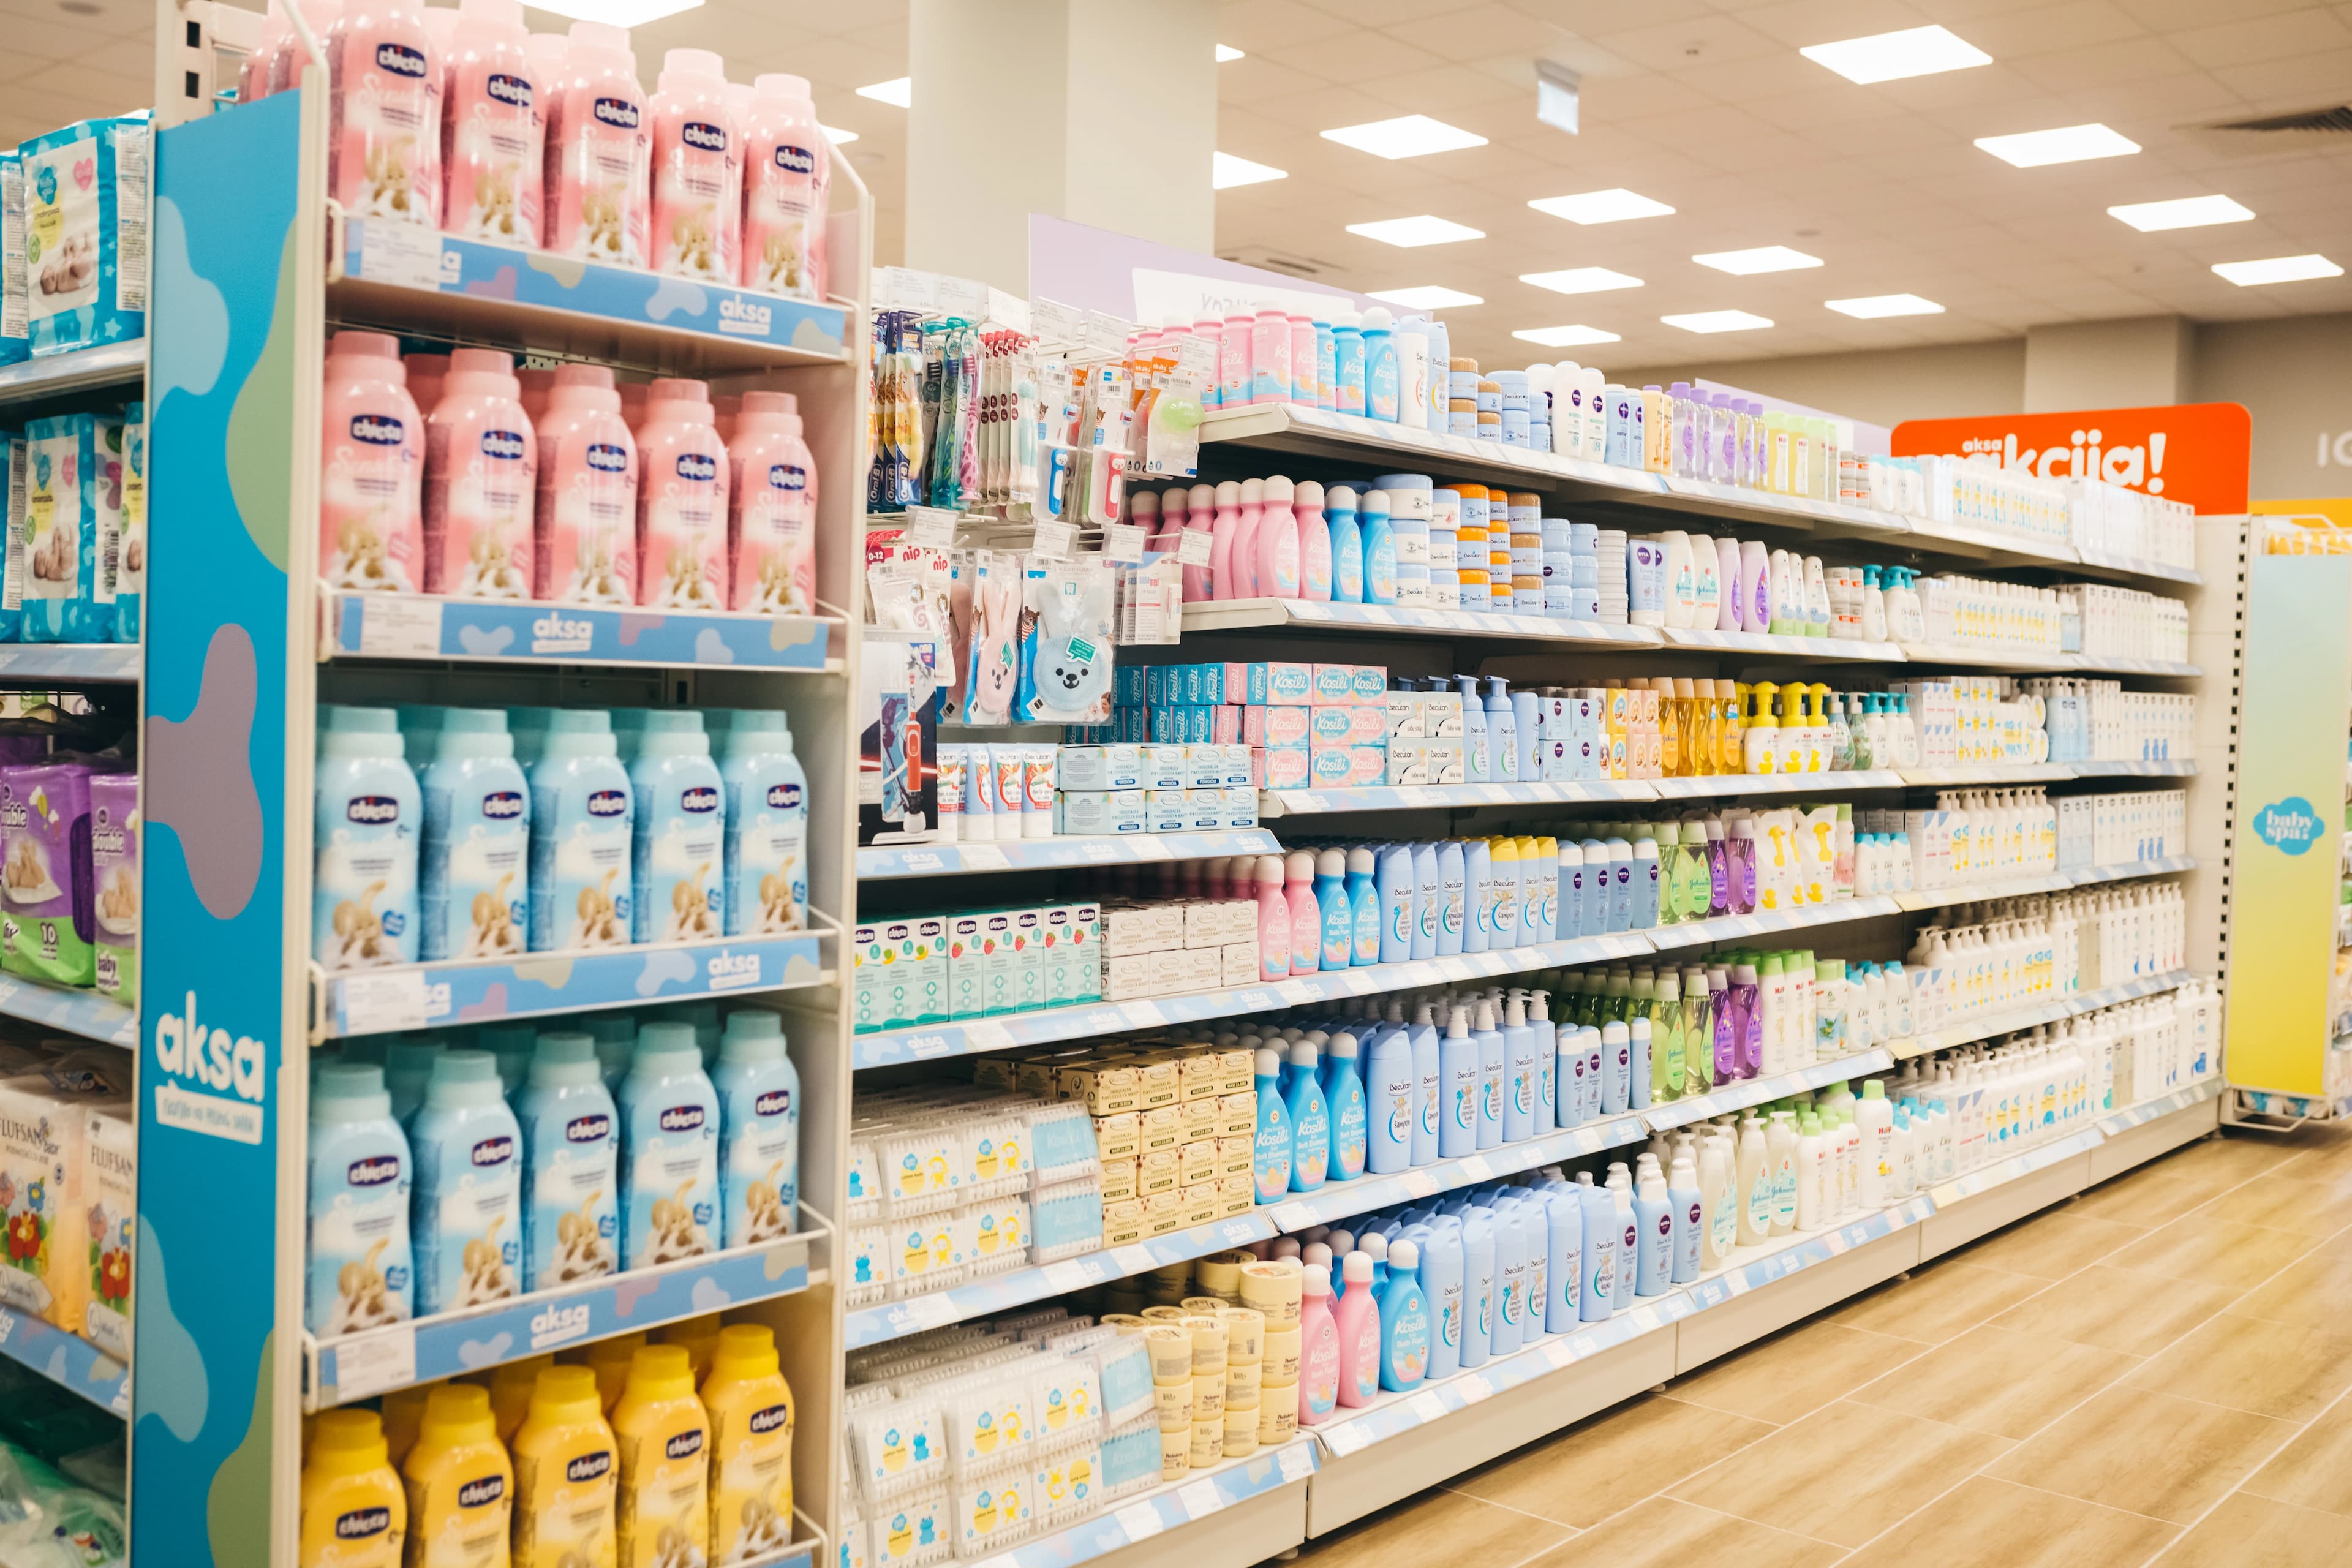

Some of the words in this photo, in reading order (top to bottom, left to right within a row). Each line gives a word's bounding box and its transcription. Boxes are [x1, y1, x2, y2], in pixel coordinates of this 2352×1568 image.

[378, 45, 425, 75] chicco
[491, 77, 532, 104] chicco
[597, 100, 638, 126] chicco
[685, 124, 725, 149] chicco
[777, 148, 813, 172] chicco
[720, 295, 771, 325] aksa
[353, 419, 403, 443] chicco
[483, 435, 523, 456] chicco
[1962, 437, 2002, 453] aksa
[589, 449, 625, 469] chicco
[679, 458, 714, 479] chicco
[772, 469, 805, 488] chicco
[868, 551, 884, 560] 0-12
[903, 546, 920, 562] nip
[933, 555, 948, 571] nip
[534, 612, 592, 641] aksa
[1274, 675, 1307, 690] Kosili
[1319, 676, 1348, 690] Kosili
[1354, 676, 1382, 690] Kosili
[1272, 717, 1303, 731] Kosili
[1317, 716, 1347, 730] Kosili
[1352, 717, 1380, 730] Kosili
[1270, 760, 1302, 773] Kosili
[1317, 758, 1346, 772] Kosili
[484, 796, 522, 817] chicco
[590, 794, 625, 815] chicco
[682, 791, 717, 812] chicco
[769, 788, 801, 808] chicco
[349, 799, 398, 822] chicco
[2267, 810, 2313, 839] baby
[990, 919, 1007, 929] chicco
[1020, 916, 1036, 925] chicco
[1050, 913, 1066, 923] chicco
[1079, 911, 1095, 920] chicco
[889, 928, 907, 938] chicco
[921, 924, 940, 935] chicco
[958, 922, 976, 932] chicco
[709, 950, 760, 976] aksa
[156, 990, 265, 1102] aksa
[1390, 1083, 1411, 1091] Becutan
[757, 1093, 789, 1115] chicco
[662, 1107, 703, 1130] chicco
[1298, 1118, 1327, 1137] Kosili
[1341, 1109, 1365, 1126] Kosili
[568, 1117, 609, 1140] chicco
[1256, 1130, 1289, 1147] Kosili
[473, 1140, 512, 1165] chicco
[349, 1159, 399, 1185] chicco
[531, 1305, 589, 1335] aksa
[1395, 1317, 1427, 1335] Kosili
[751, 1408, 786, 1432] chicco
[667, 1432, 703, 1458] chicco
[568, 1454, 610, 1480] chicco
[460, 1477, 503, 1506] chicco
[337, 1510, 390, 1537] chicco
